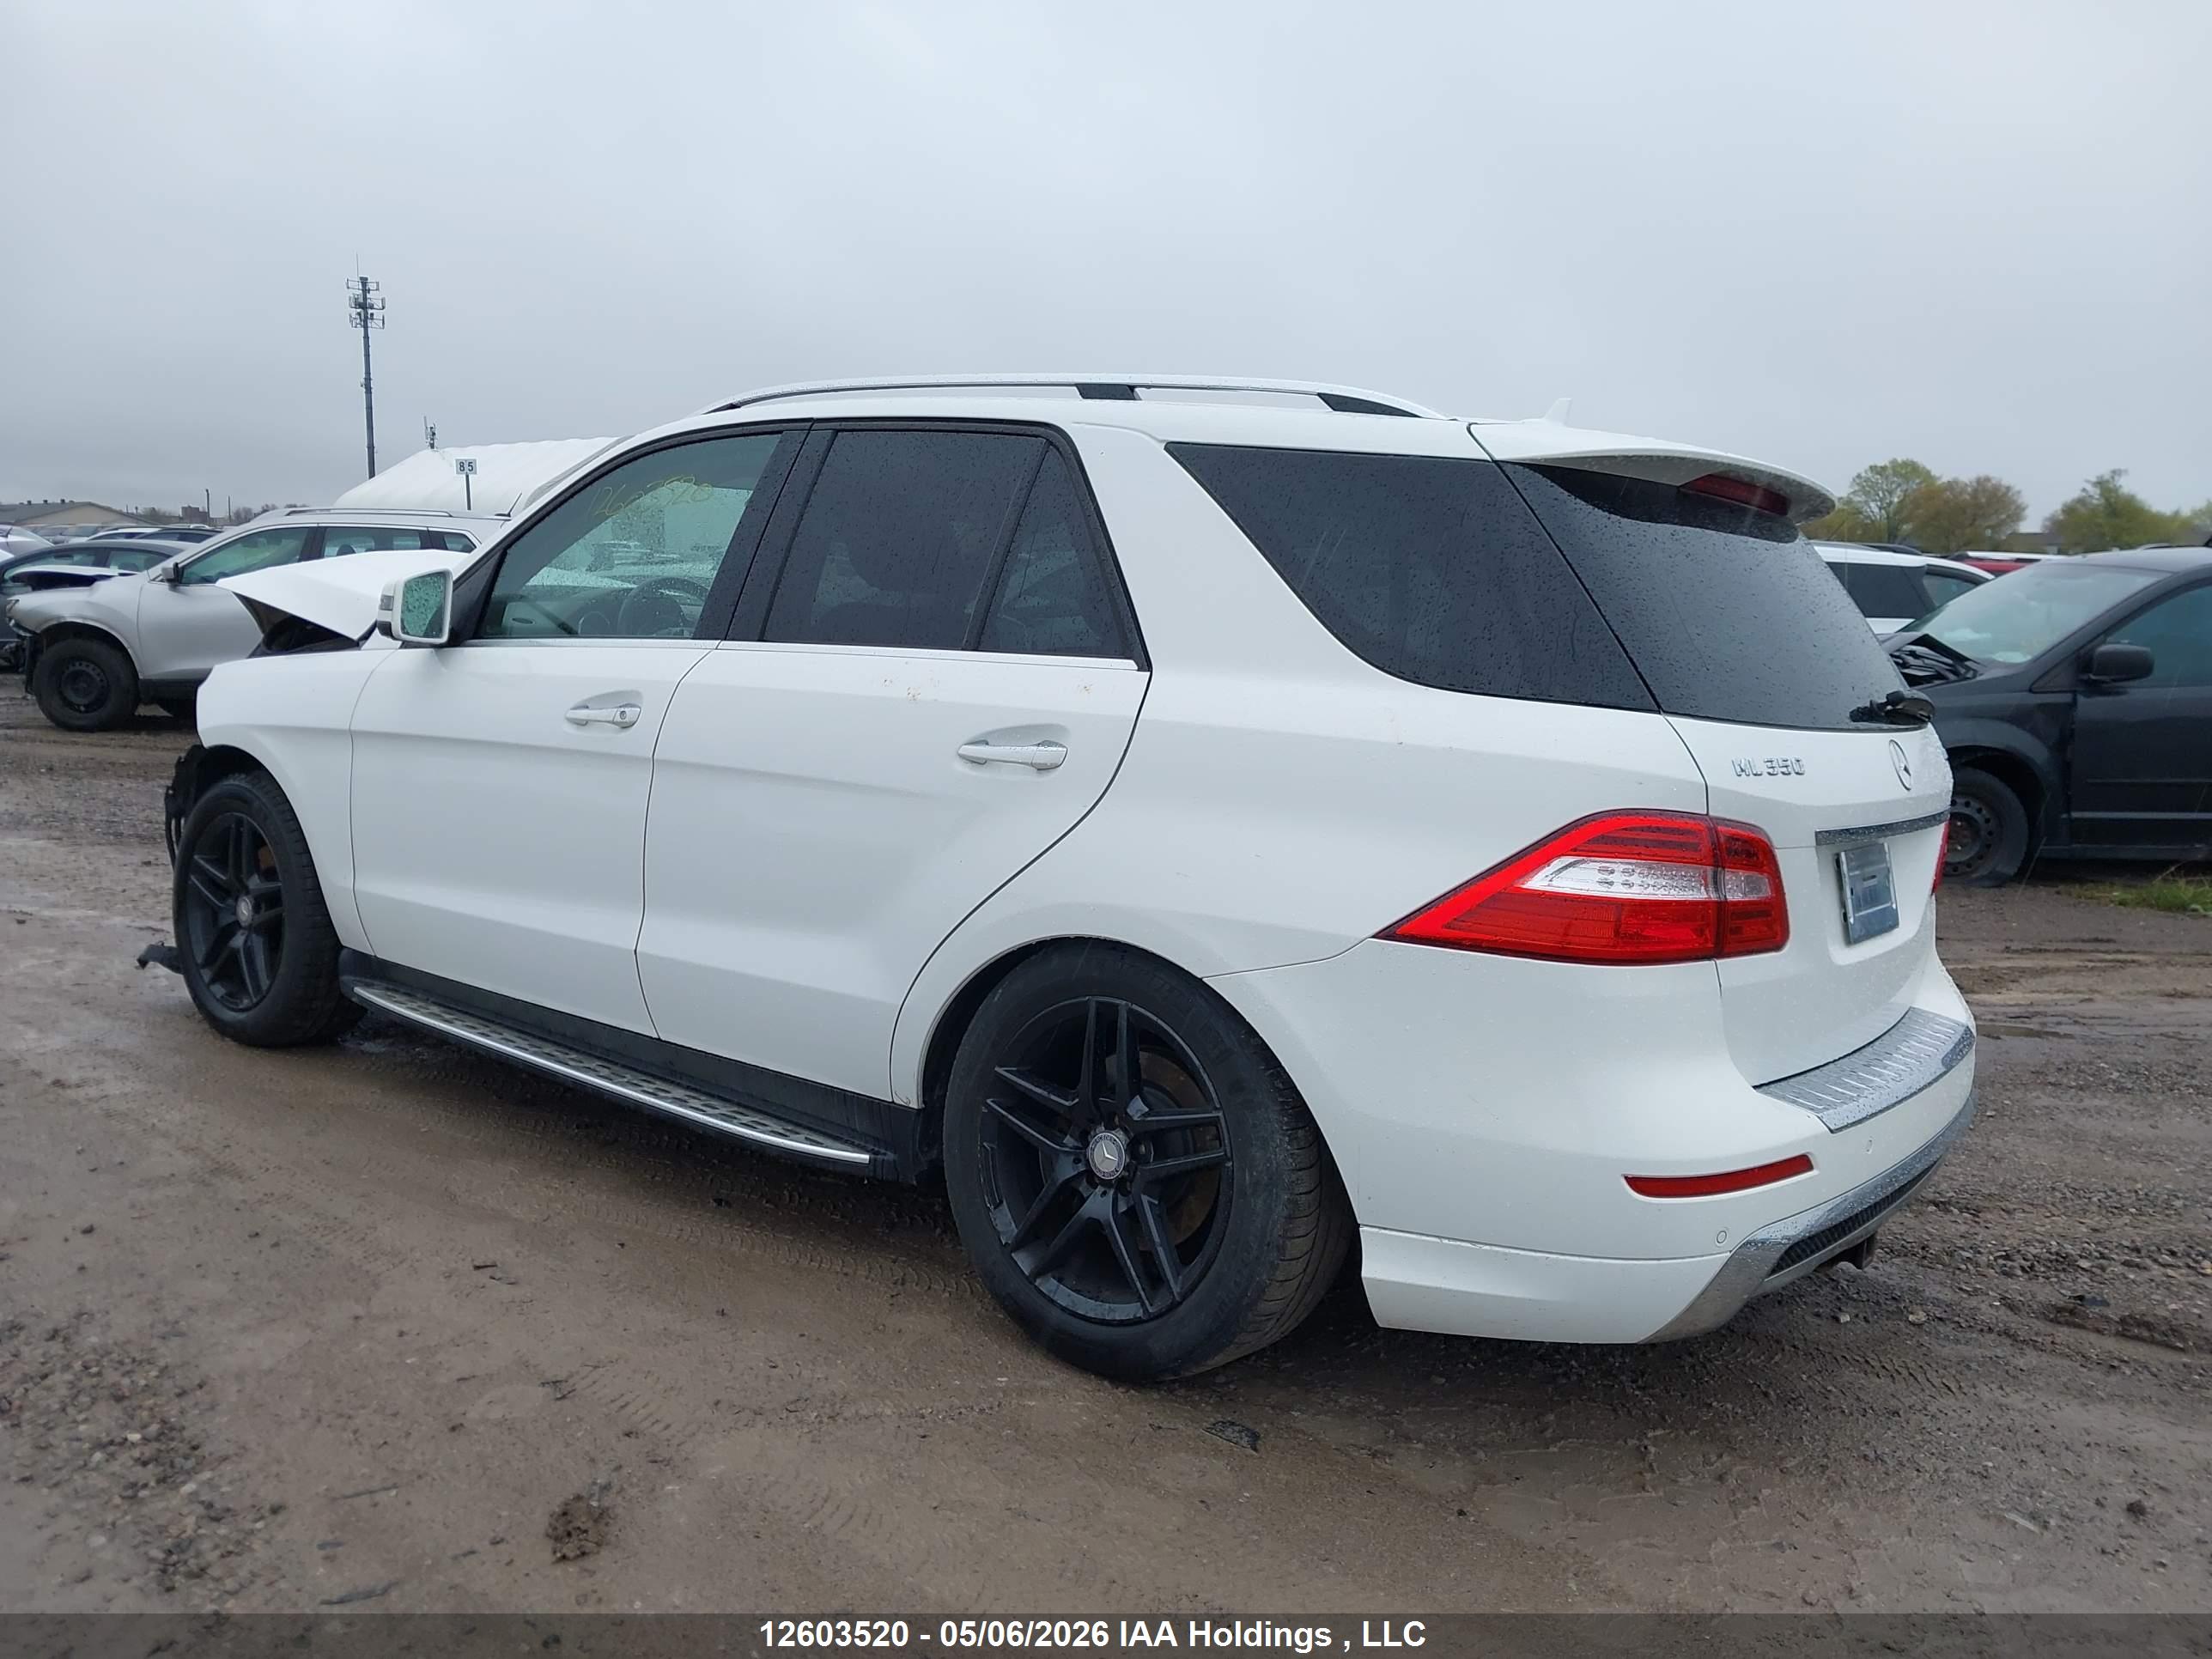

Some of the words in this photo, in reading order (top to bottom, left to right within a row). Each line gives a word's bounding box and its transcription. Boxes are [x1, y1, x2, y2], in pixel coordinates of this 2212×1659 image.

[459, 461, 474, 472] 85
[1731, 757, 1763, 776] ML
[1763, 757, 1806, 776] 350
